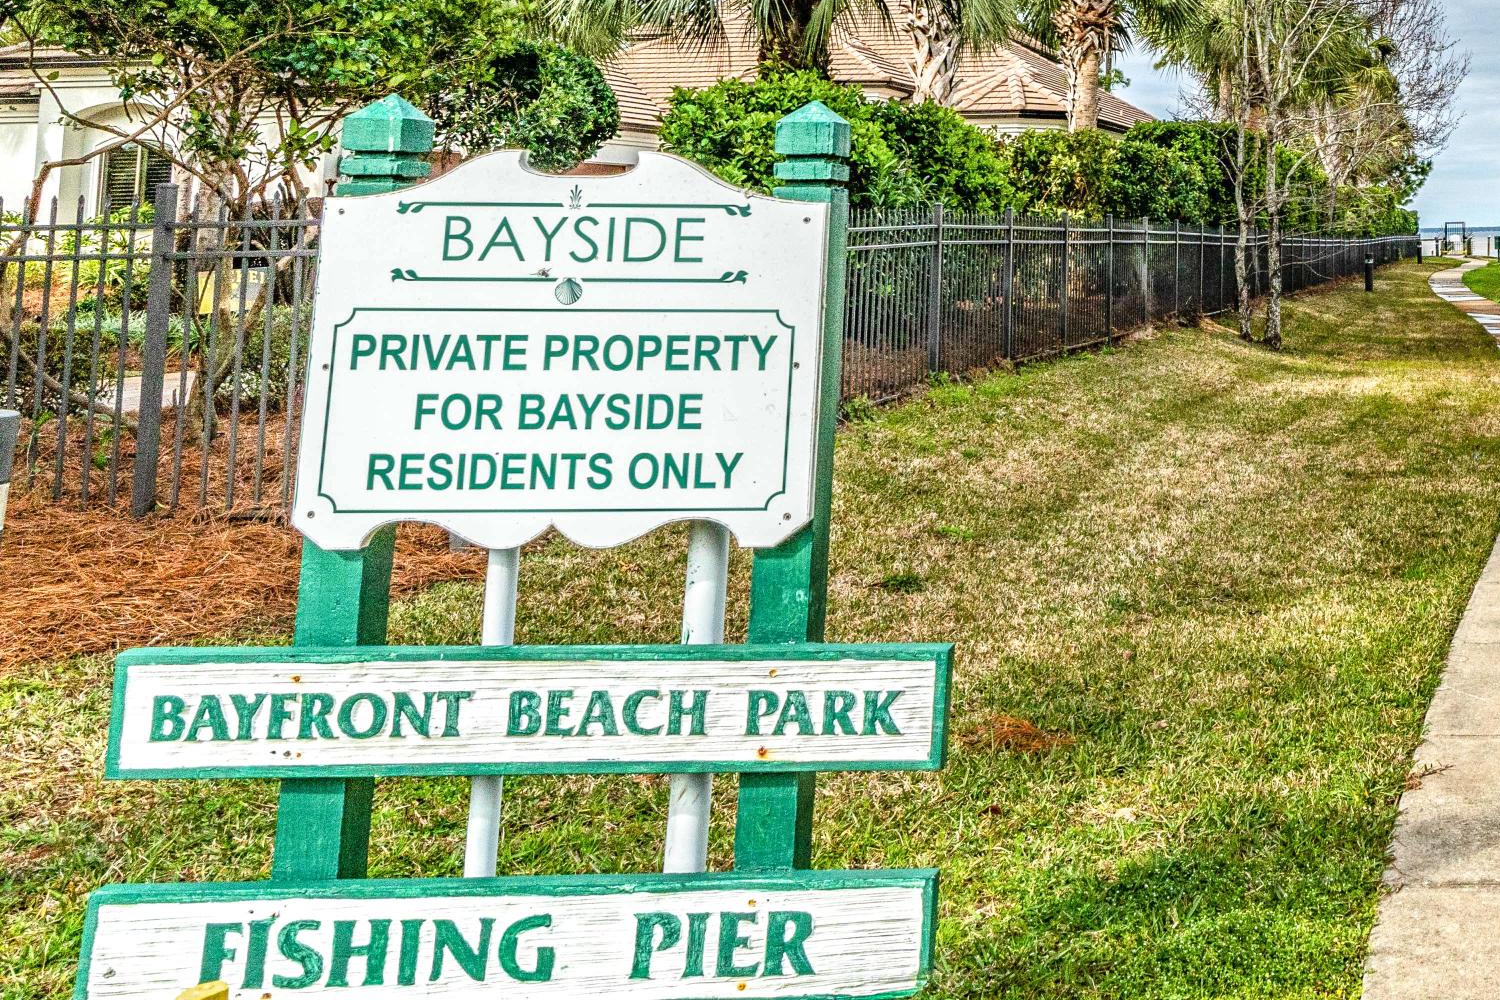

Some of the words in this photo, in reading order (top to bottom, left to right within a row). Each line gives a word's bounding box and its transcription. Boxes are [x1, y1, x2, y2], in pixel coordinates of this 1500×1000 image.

[441, 215, 706, 264] BAYSIDE
[350, 333, 529, 372] PRIVATE
[543, 333, 779, 373] PROPERTY
[413, 392, 504, 432] FOR
[517, 392, 705, 432] BAYSIDE
[366, 451, 614, 492] RESIDENTS
[628, 450, 744, 490] ONLY
[148, 689, 474, 743] BAYFRONT
[505, 688, 710, 738] BEACH
[744, 688, 905, 737] PARK
[199, 912, 557, 991] FISHING
[629, 910, 817, 982] PIER
